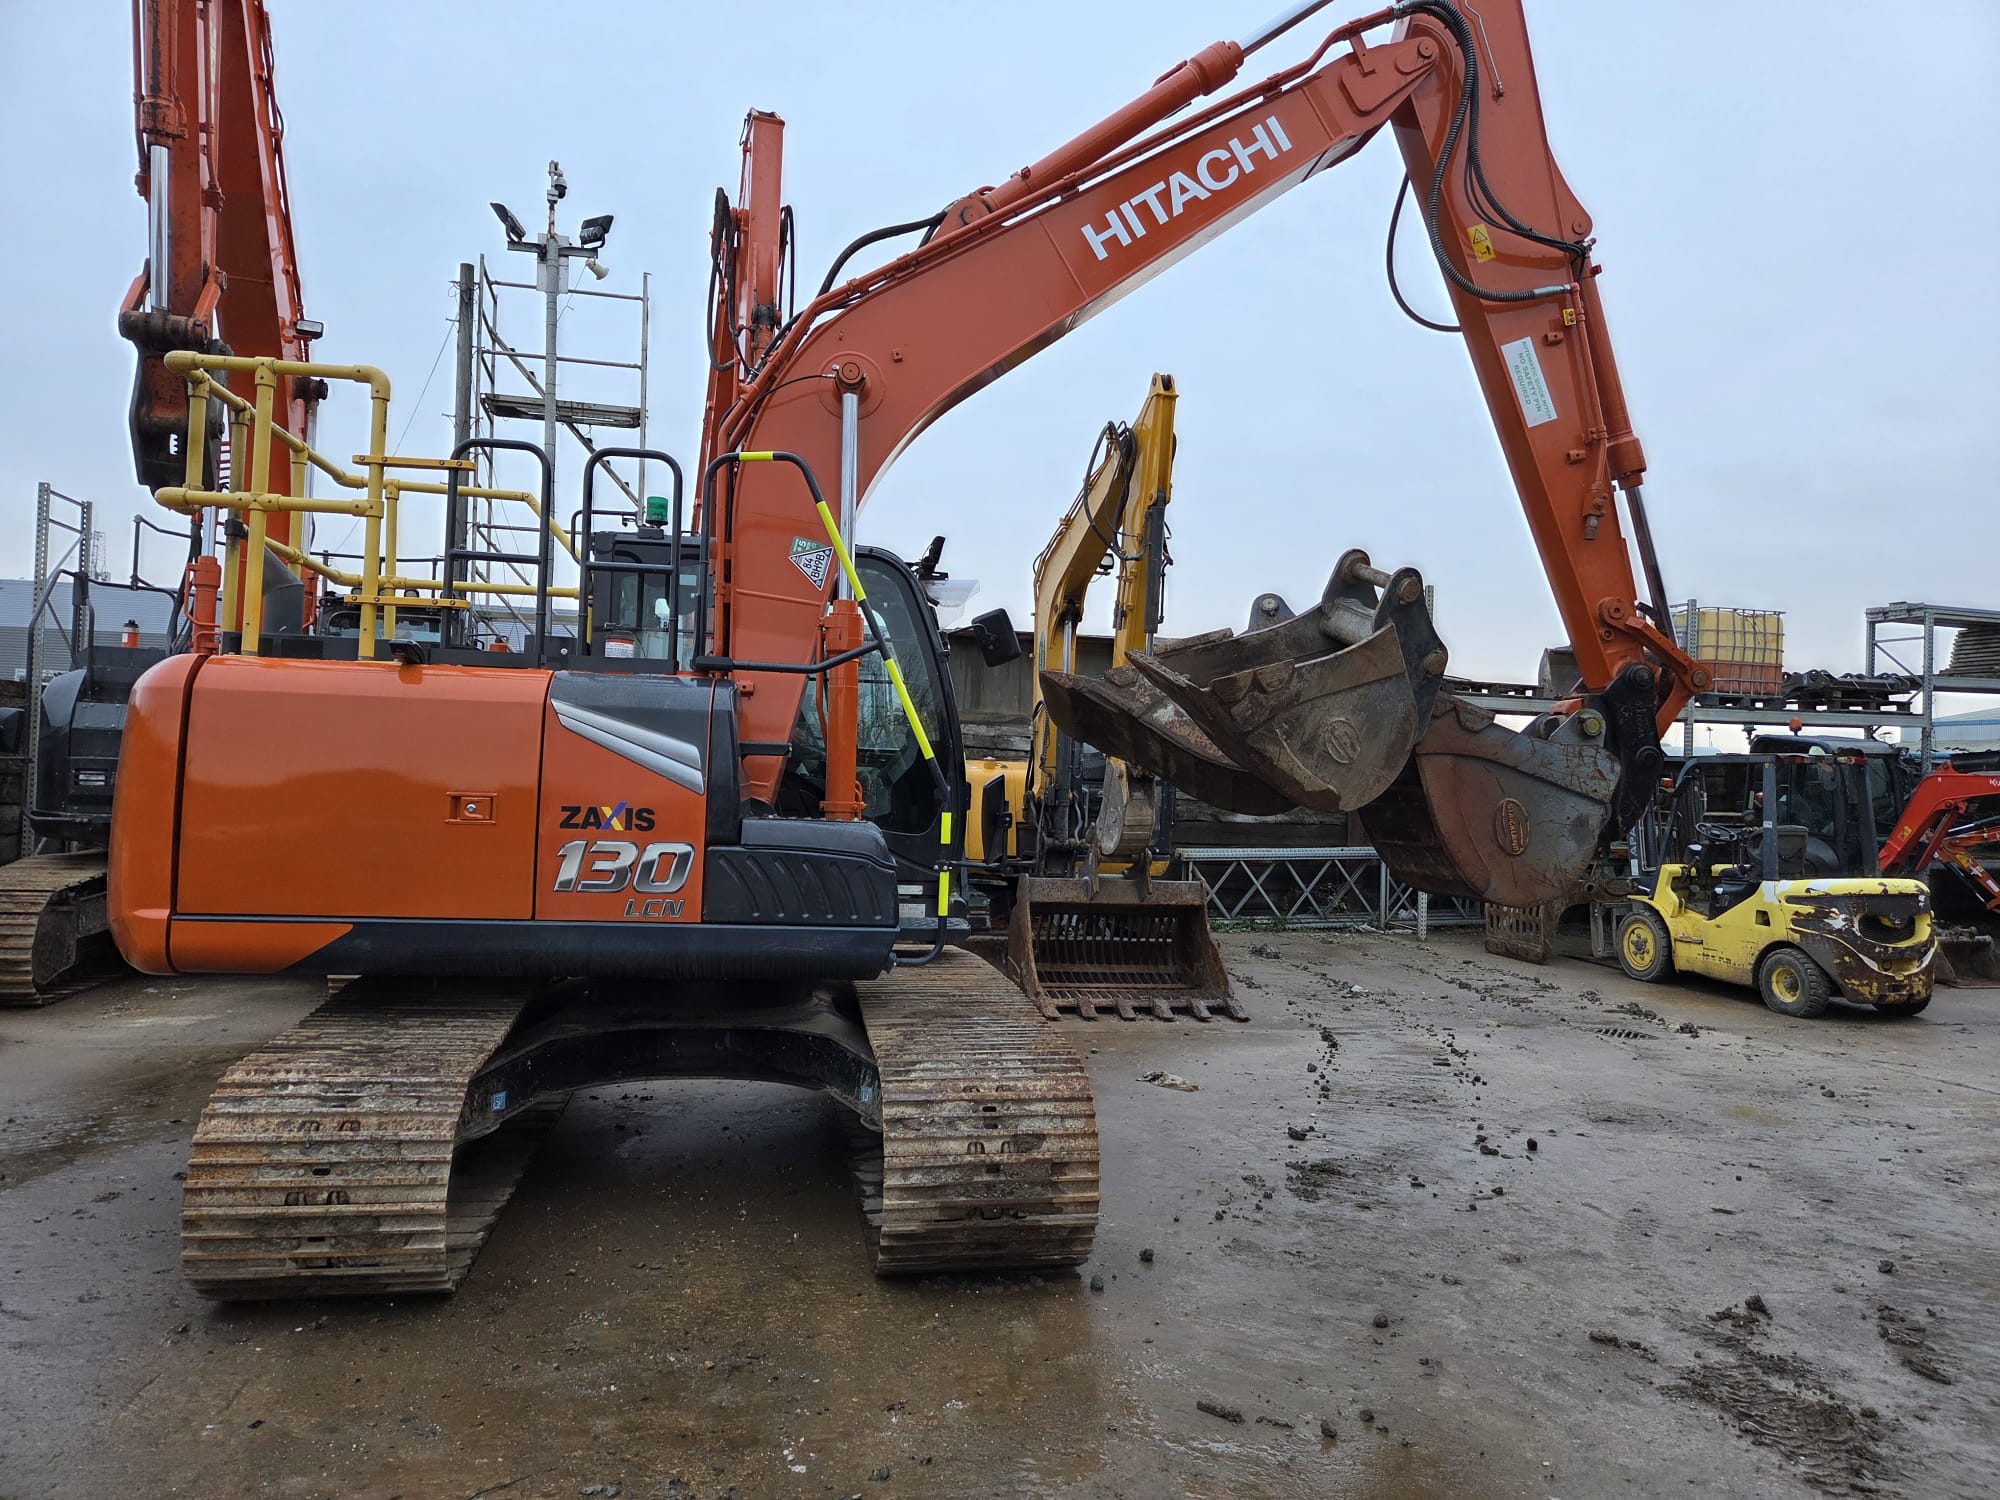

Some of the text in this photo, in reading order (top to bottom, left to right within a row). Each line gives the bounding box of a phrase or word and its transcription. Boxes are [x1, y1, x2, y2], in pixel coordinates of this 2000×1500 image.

[1080, 115, 1293, 261] HITACHI
[1514, 364, 1531, 405] REQUIRED
[1518, 352, 1542, 412] NO SAFETY PIN
[1521, 340, 1553, 419] AUTOMATIC QUICK HITCH
[803, 558, 813, 568] 84
[810, 553, 825, 578] BH9B
[560, 802, 656, 831] ZAXIS
[553, 840, 696, 894] 130
[623, 898, 685, 918] LCN
